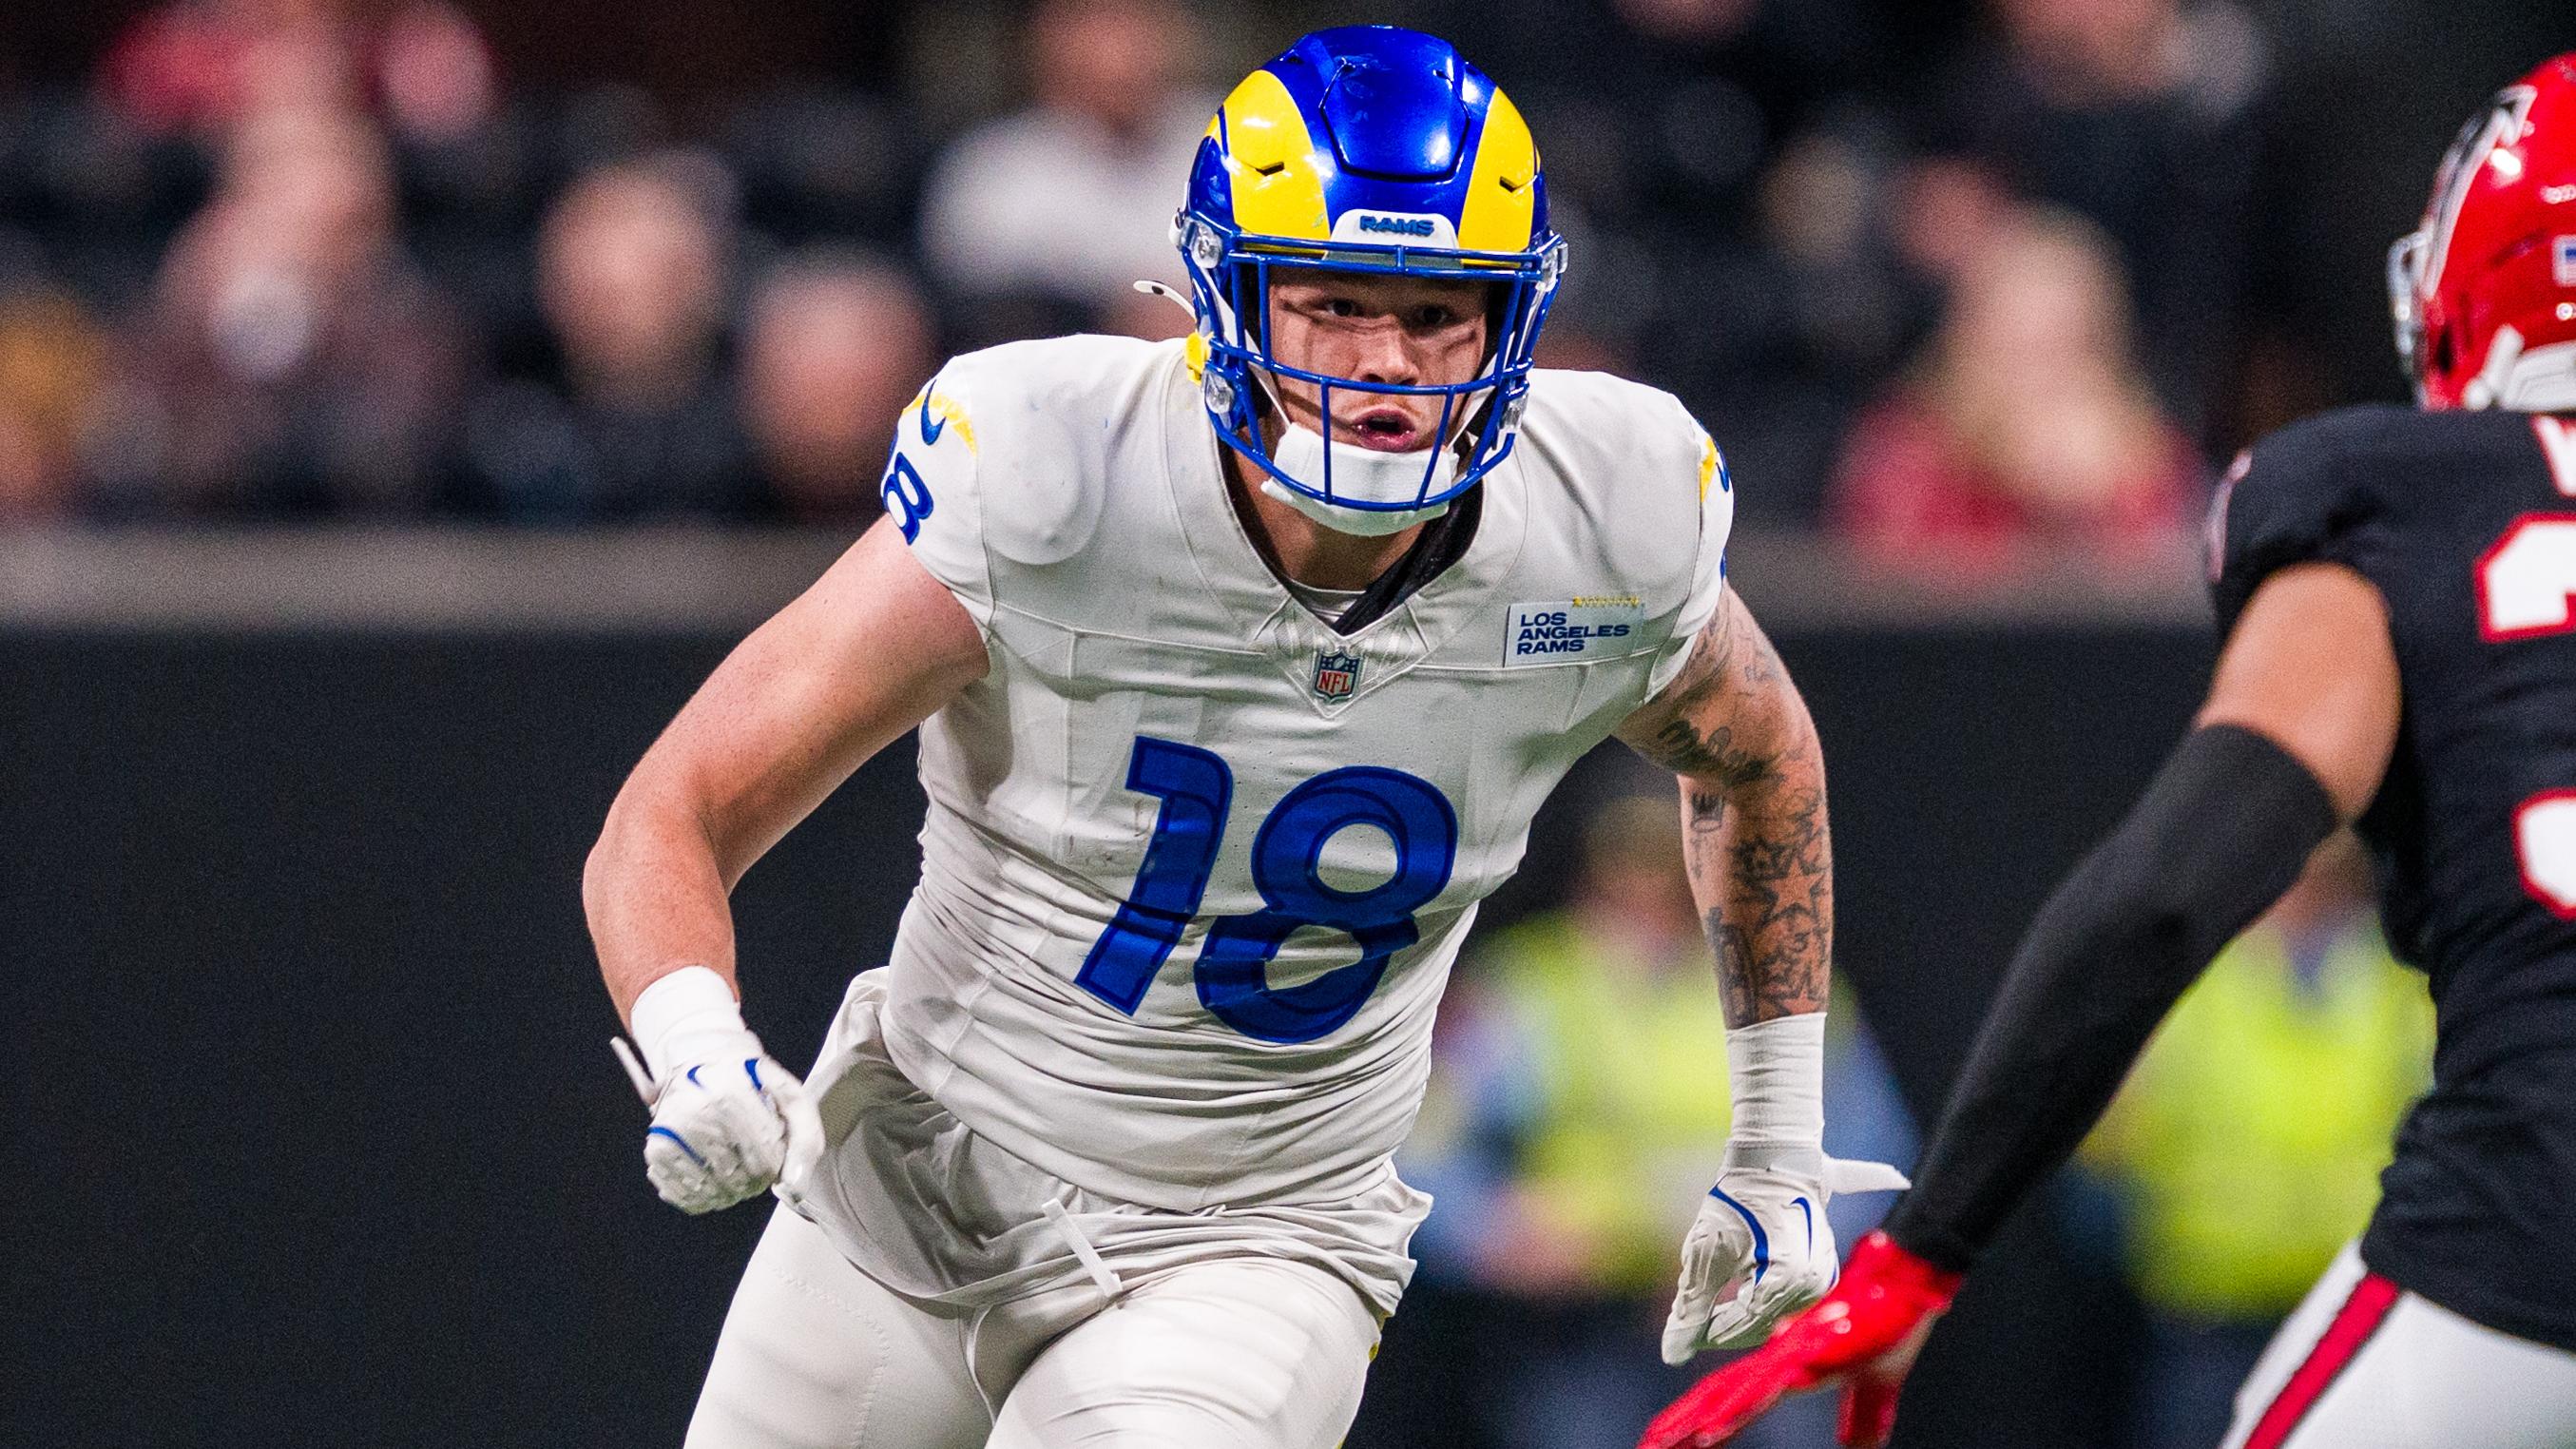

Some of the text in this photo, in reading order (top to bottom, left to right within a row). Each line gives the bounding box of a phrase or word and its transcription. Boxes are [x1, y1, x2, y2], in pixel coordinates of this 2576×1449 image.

[1360, 216, 1435, 237] RAMS
[883, 434, 934, 545] 8
[1520, 611, 1567, 628] LOS
[1517, 624, 1630, 642] ANGELES
[1516, 639, 1586, 655] RAMS
[1318, 671, 1350, 695] NFL
[1073, 735, 1458, 1045] 18
